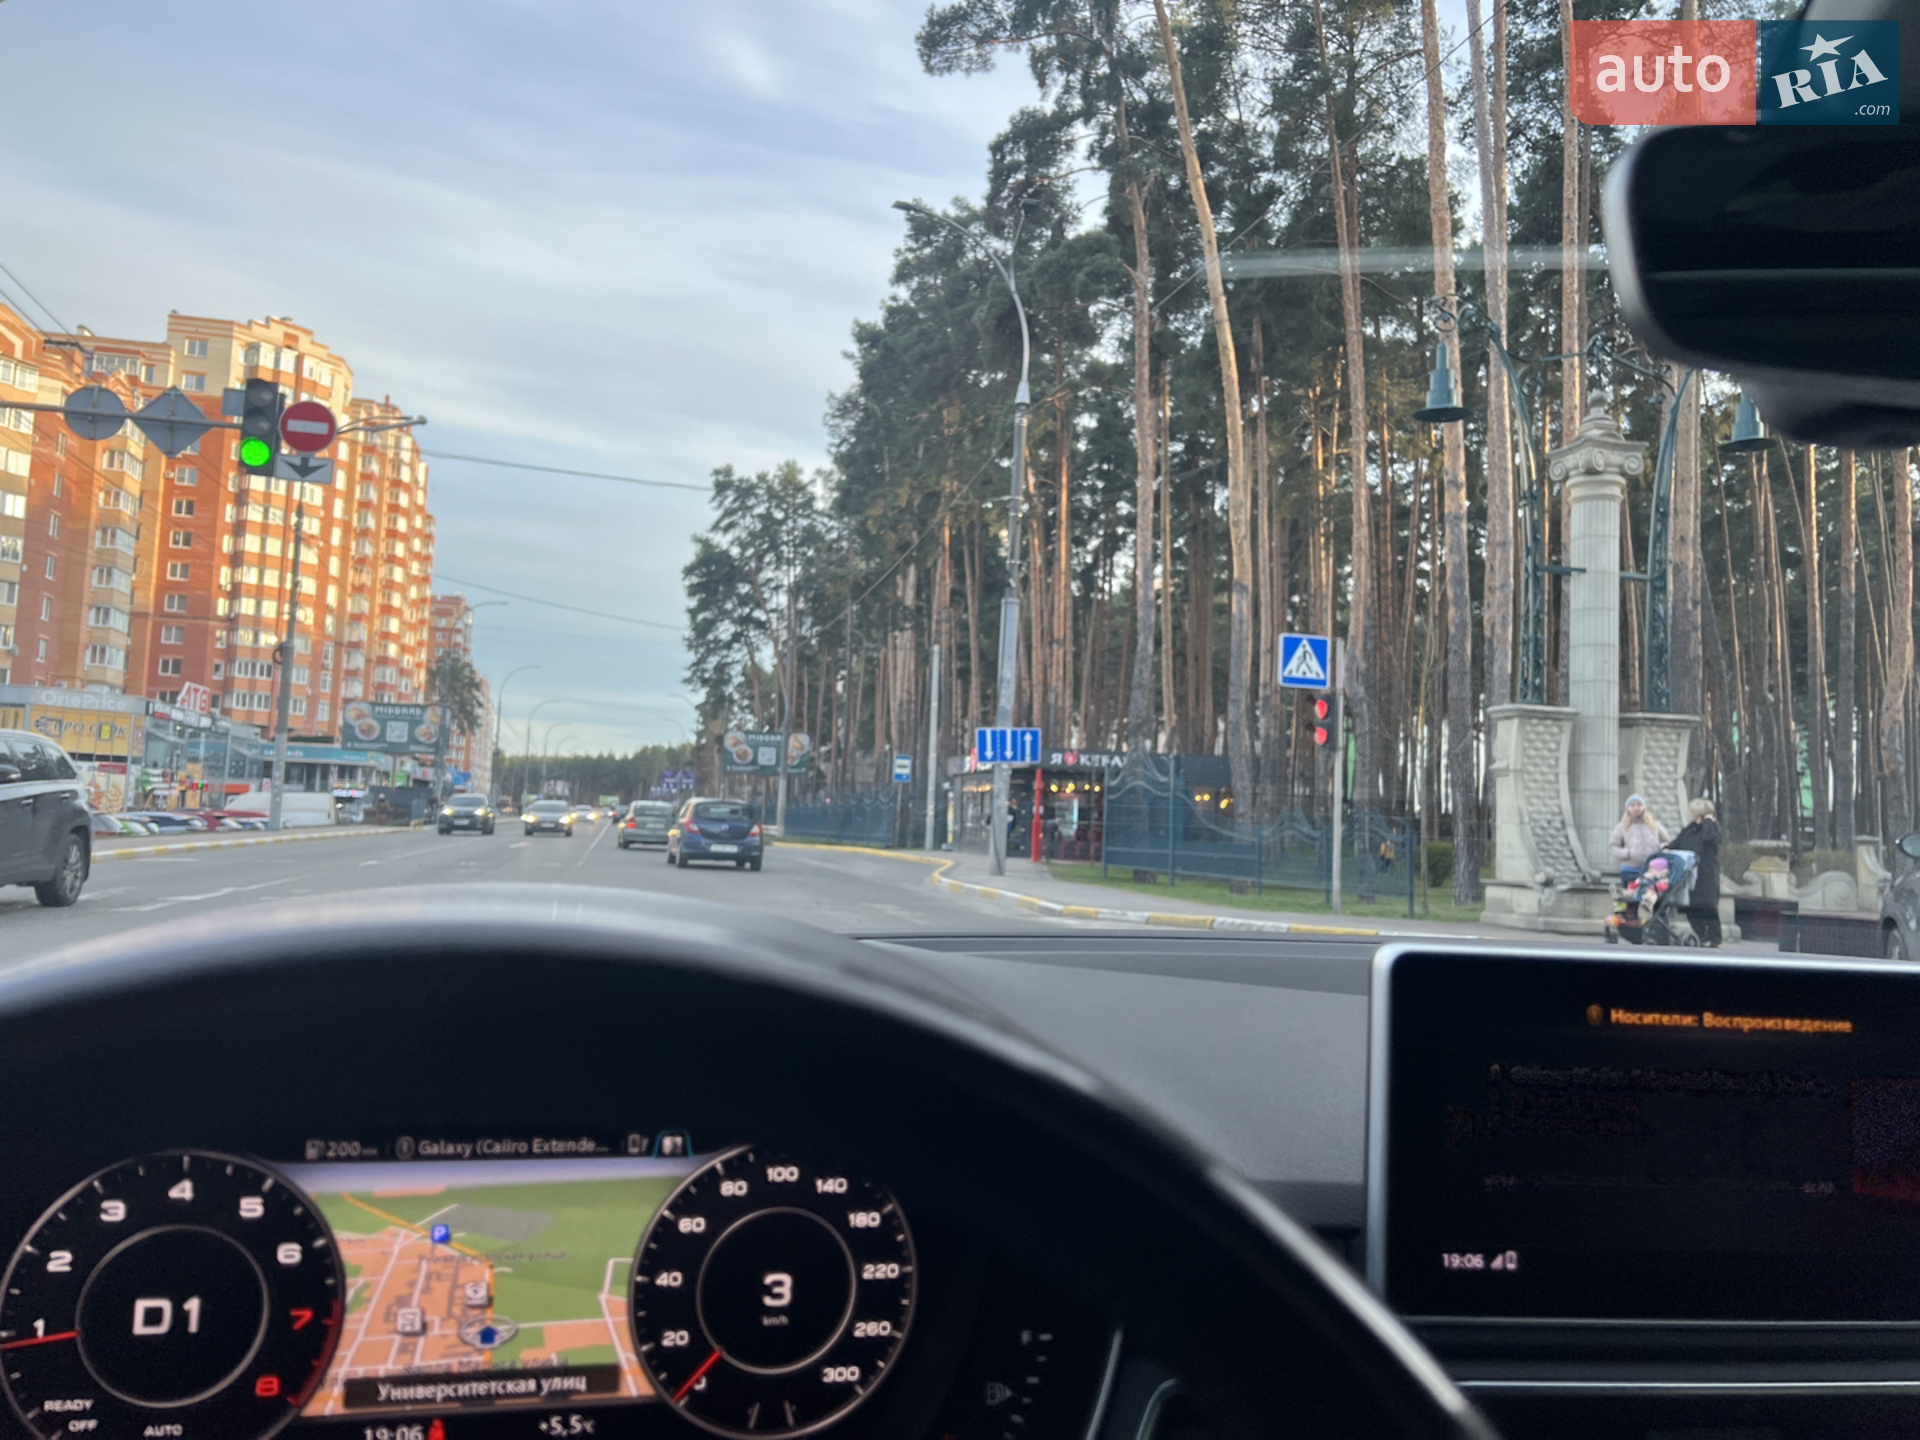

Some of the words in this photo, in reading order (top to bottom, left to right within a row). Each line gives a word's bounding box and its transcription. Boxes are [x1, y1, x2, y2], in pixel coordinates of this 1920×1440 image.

[41, 690, 126, 710] OnePrice
[326, 1141, 362, 1157] 200
[418, 1140, 473, 1158] Galaxy
[766, 1166, 799, 1183] 100
[168, 1179, 194, 1201] 4
[719, 1180, 748, 1197] 80
[815, 1177, 848, 1194] 140
[100, 1199, 126, 1222] 3
[239, 1196, 265, 1218] 5
[678, 1216, 706, 1234] 60
[848, 1211, 881, 1228] 180
[46, 1250, 73, 1272] 2
[276, 1242, 302, 1264] 6
[1442, 1253, 1484, 1269] 19:06
[655, 1271, 683, 1287] 40
[862, 1262, 899, 1280] 220
[763, 1272, 793, 1307] 3
[132, 1296, 201, 1335] D1
[290, 1308, 313, 1330] 7
[33, 1318, 45, 1337] 1
[854, 1321, 892, 1337] 260
[661, 1330, 690, 1347] 20
[822, 1365, 860, 1382] 300
[255, 1375, 281, 1397] 8
[378, 1377, 537, 1402] Университетская
[43, 1399, 94, 1412] READY
[68, 1419, 98, 1432] OFF
[143, 1424, 183, 1437] AUTO
